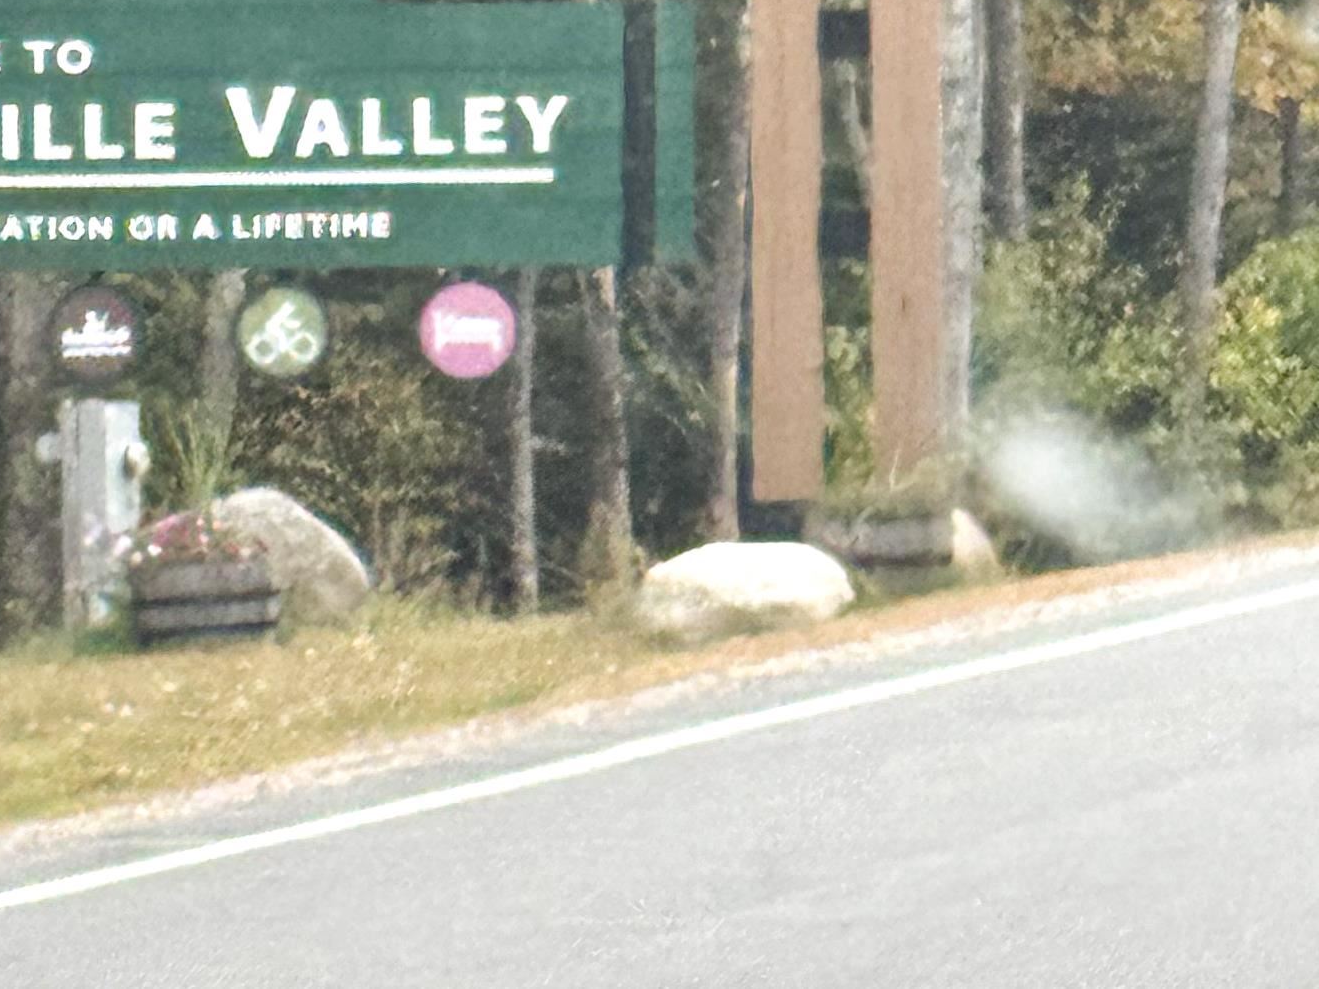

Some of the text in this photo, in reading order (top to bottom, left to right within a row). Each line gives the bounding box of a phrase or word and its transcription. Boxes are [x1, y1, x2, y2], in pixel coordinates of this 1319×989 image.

[22, 38, 94, 75] TO
[224, 84, 570, 159] VALLEY
[126, 212, 178, 241] OR
[192, 212, 219, 241] A
[232, 210, 392, 240] LIFETIME
